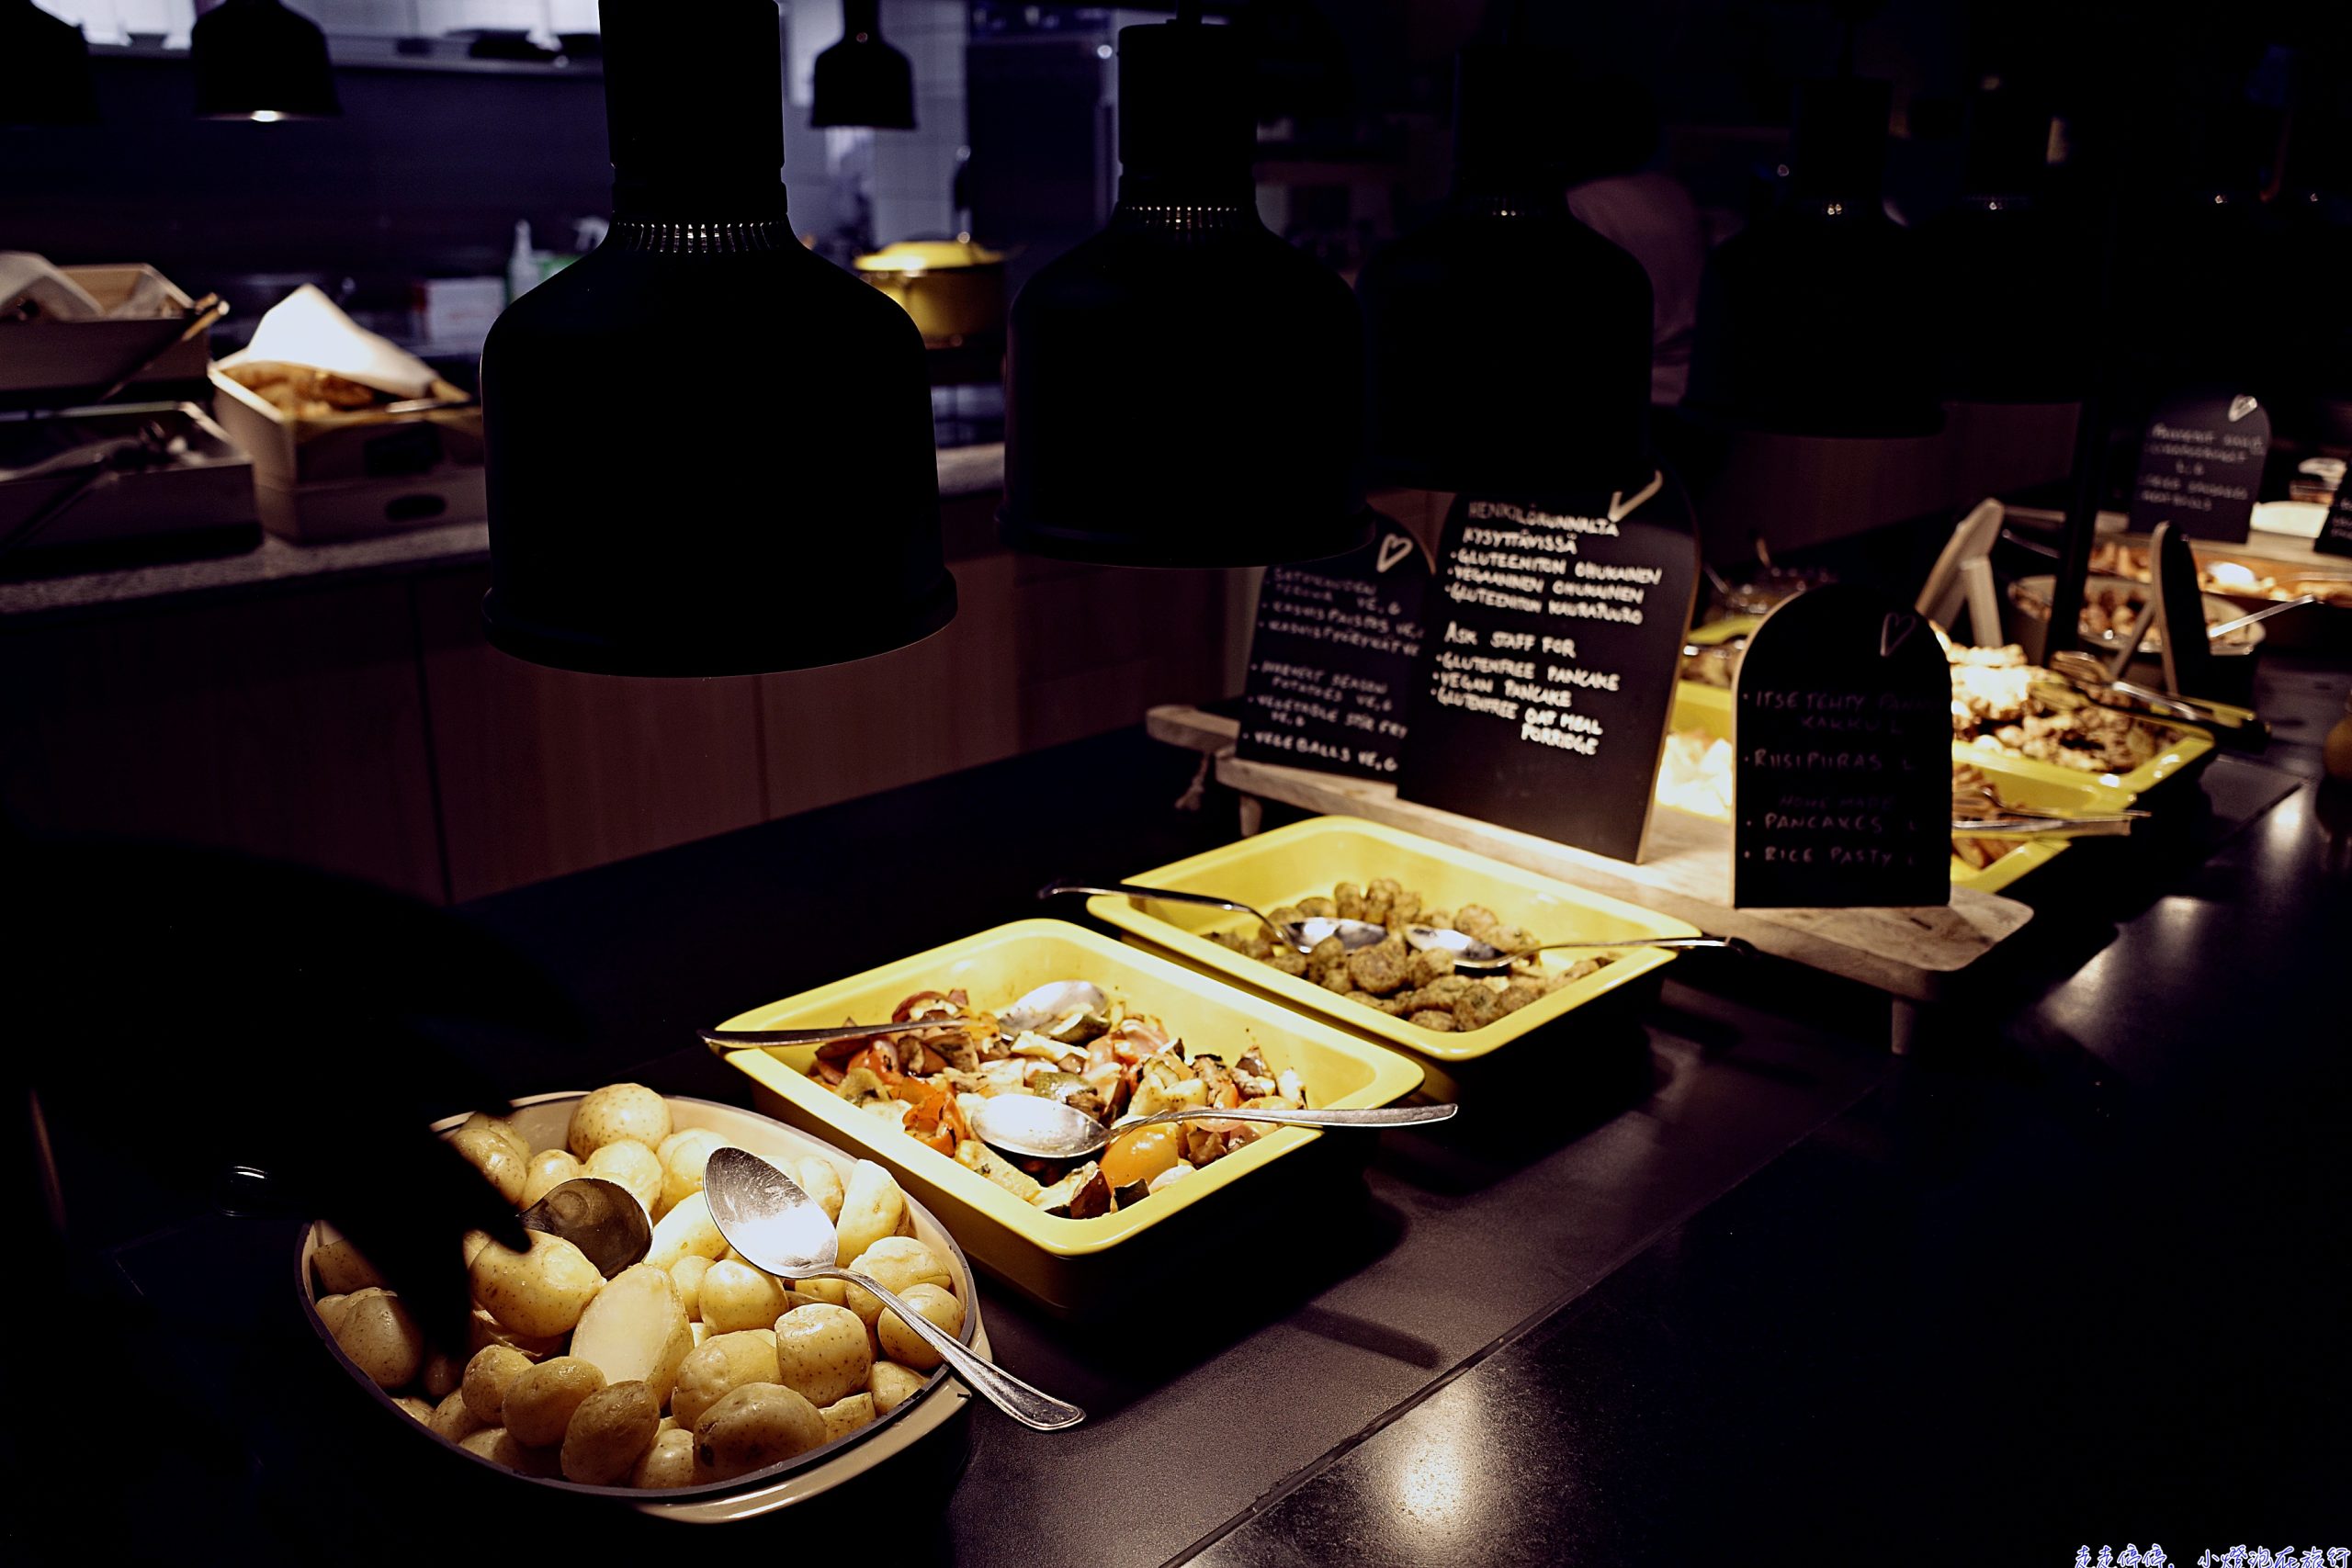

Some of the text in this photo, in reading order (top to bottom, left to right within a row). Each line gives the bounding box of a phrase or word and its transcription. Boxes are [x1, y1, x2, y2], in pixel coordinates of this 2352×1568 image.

[1463, 526, 1577, 555] KYSYTTÄVISSÄ
[1458, 547, 1662, 585] GLUTEENITON OHUKAINEN
[1454, 564, 1645, 604] VEGAANINEN OHUKAINEN
[1450, 581, 1643, 625] GLUTEENITON KAURAPUURO
[1490, 630, 1536, 652] STAFF
[1542, 636, 1577, 659] FOR
[1442, 650, 1621, 691] GLUTENFREE PANCAKE
[1441, 671, 1572, 707] VEGAN PANCAKE
[1756, 689, 1800, 710] ITSE
[1437, 685, 1603, 735] GLUTENFREE OAT MEAL
[1295, 736, 1352, 763] BALLS
[1521, 723, 1600, 755] PORRIDGE
[1764, 811, 1883, 834] PANCAKES
[1764, 845, 1815, 863] RICE
[1829, 845, 1894, 872] PASTY
